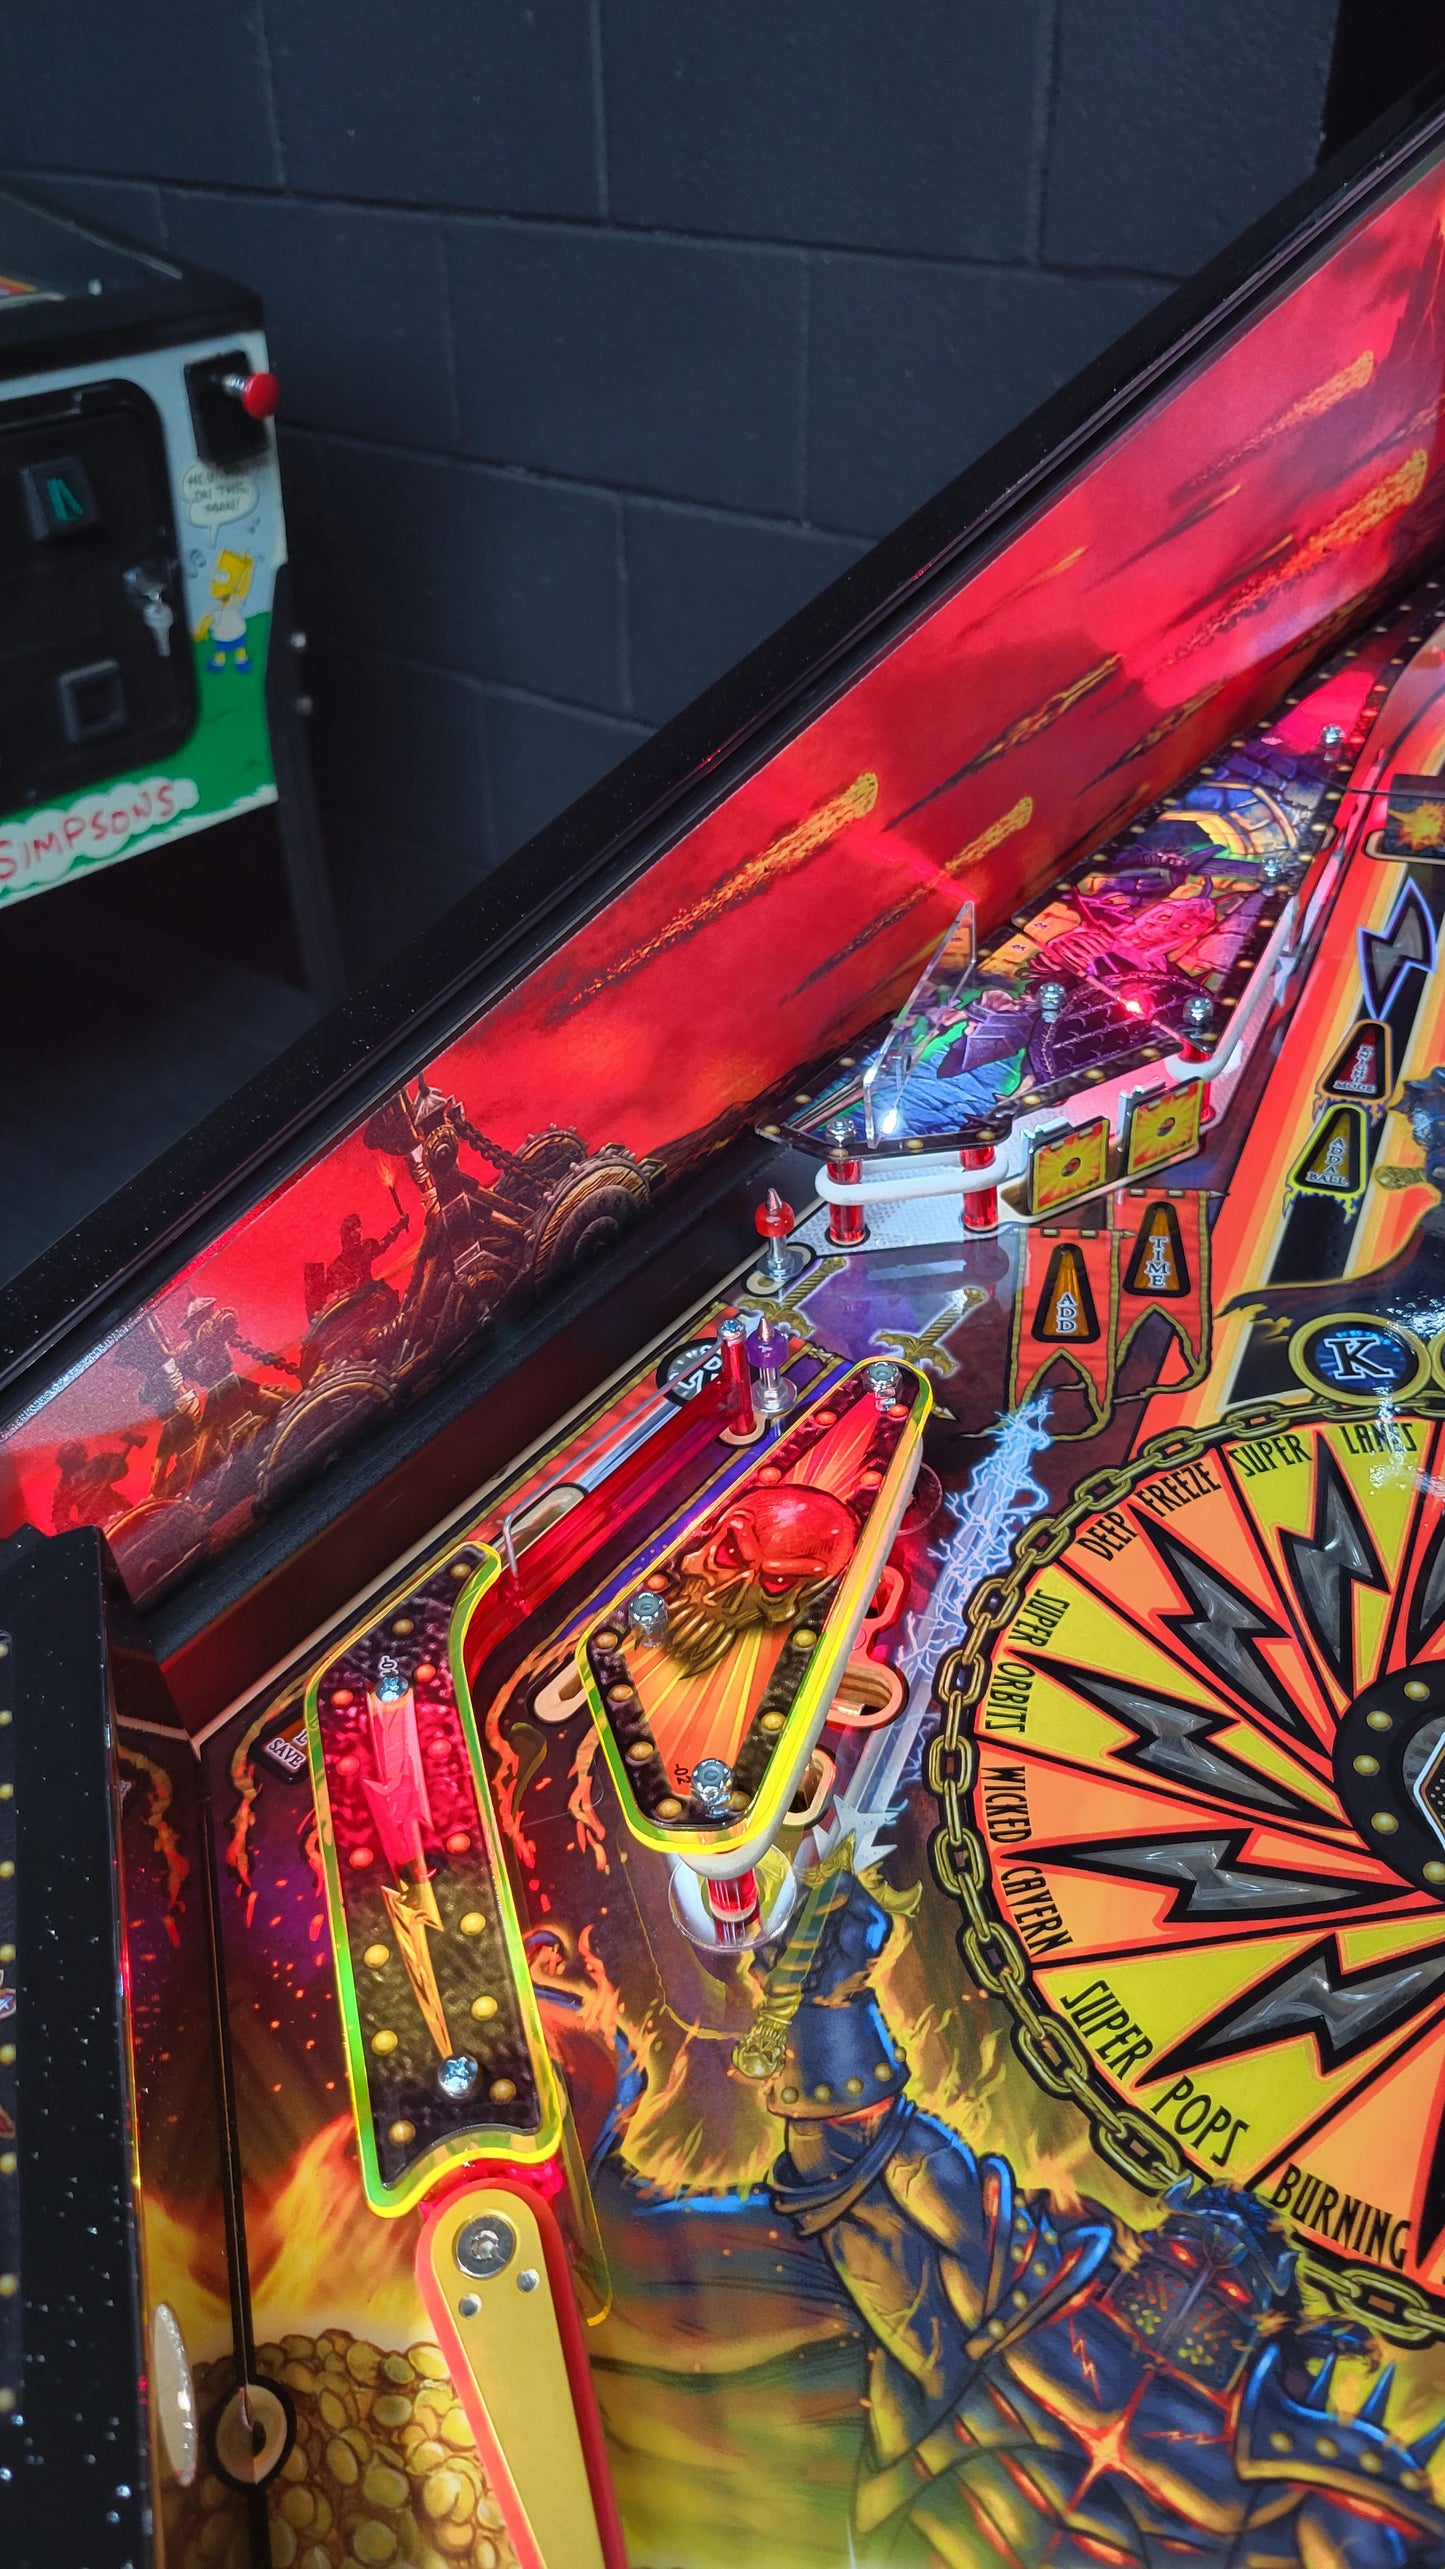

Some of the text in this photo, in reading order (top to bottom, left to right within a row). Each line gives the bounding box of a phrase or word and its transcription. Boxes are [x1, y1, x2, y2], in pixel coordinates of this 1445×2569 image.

[0, 782, 174, 881] SIMPSONS
[1325, 1136, 1347, 1165] ADD
[1305, 1171, 1350, 1187] BALL
[1144, 1236, 1169, 1289] TIME
[1056, 1291, 1077, 1333] ADD
[1324, 1337, 1395, 1380] K
[1228, 1434, 1313, 1478] SUPER
[1076, 1461, 1222, 1562] DEEP FREEZE
[985, 1588, 1070, 1733] SUPER ORBITS
[266, 1737, 307, 1770] SAVE
[980, 1765, 1074, 1958] WICKED CAVERN
[1059, 1979, 1251, 2168] SUPER POPS
[1269, 2162, 1412, 2270] BURNING
